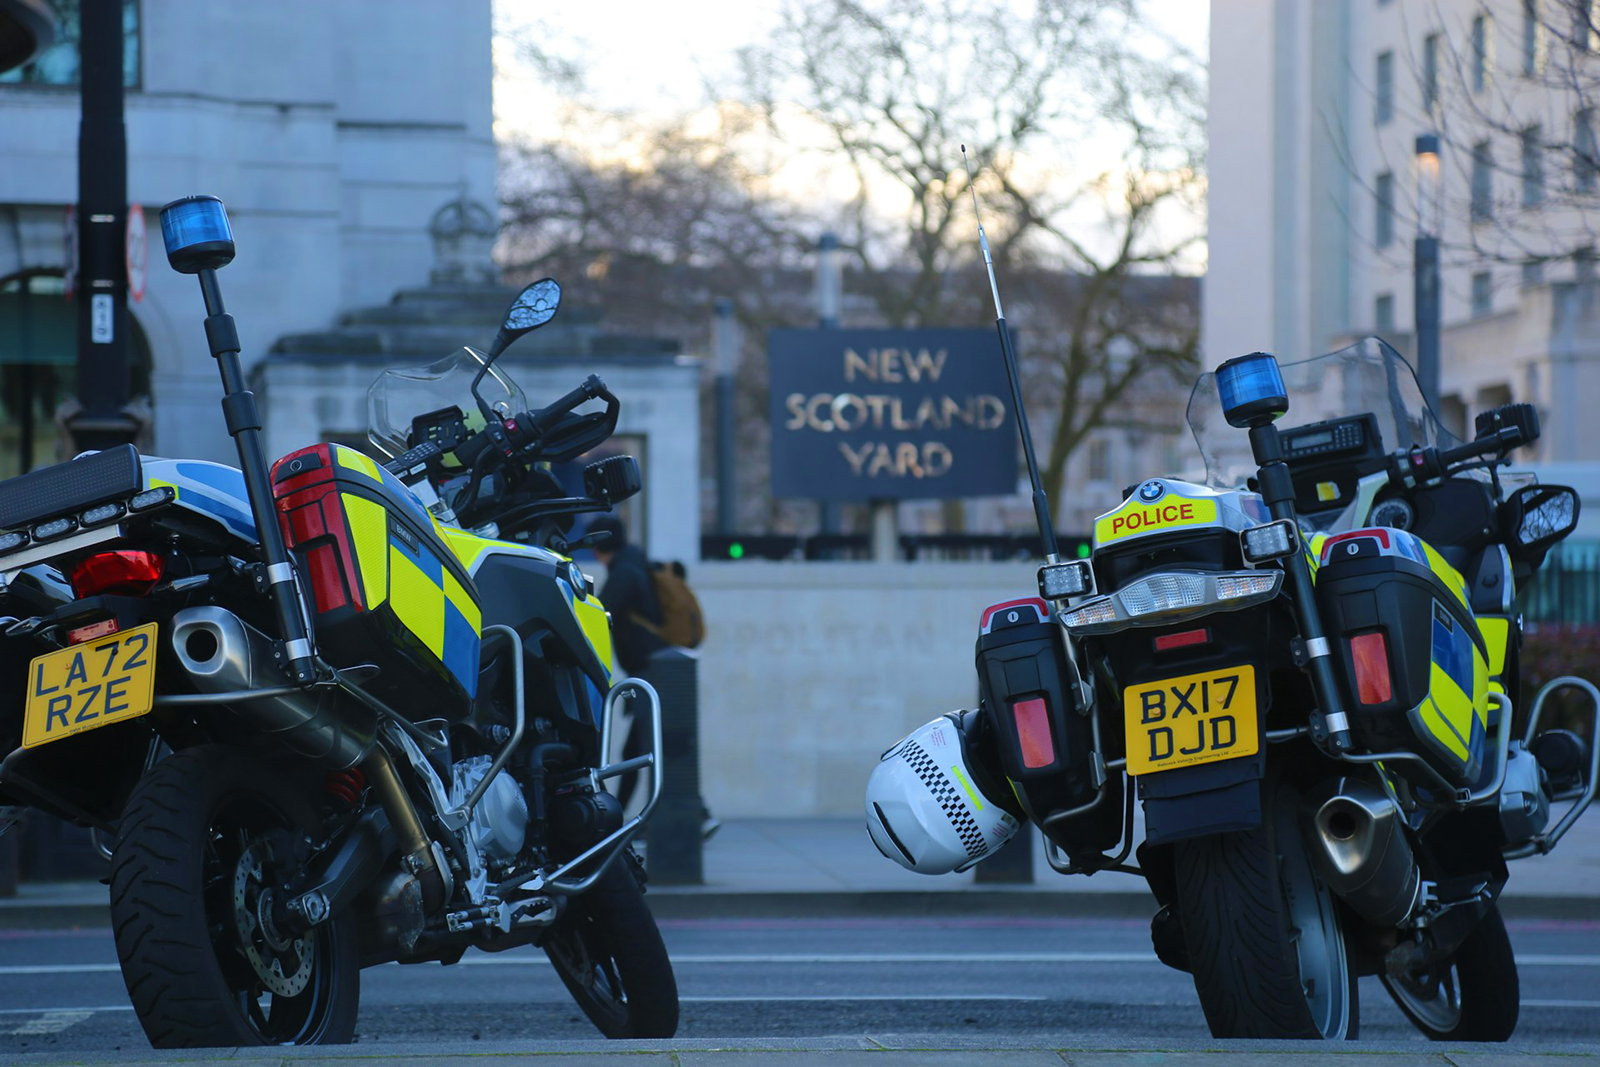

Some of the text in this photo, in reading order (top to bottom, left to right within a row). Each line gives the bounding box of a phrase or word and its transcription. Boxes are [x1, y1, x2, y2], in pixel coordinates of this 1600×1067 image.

[843, 347, 948, 384] NEW
[785, 392, 1006, 432] SCOTLAND
[838, 441, 954, 479] YARD
[1112, 503, 1195, 535] POLICE
[46, 675, 132, 733] RZE
[1140, 674, 1239, 725] BX17
[1147, 715, 1237, 762] DJD
